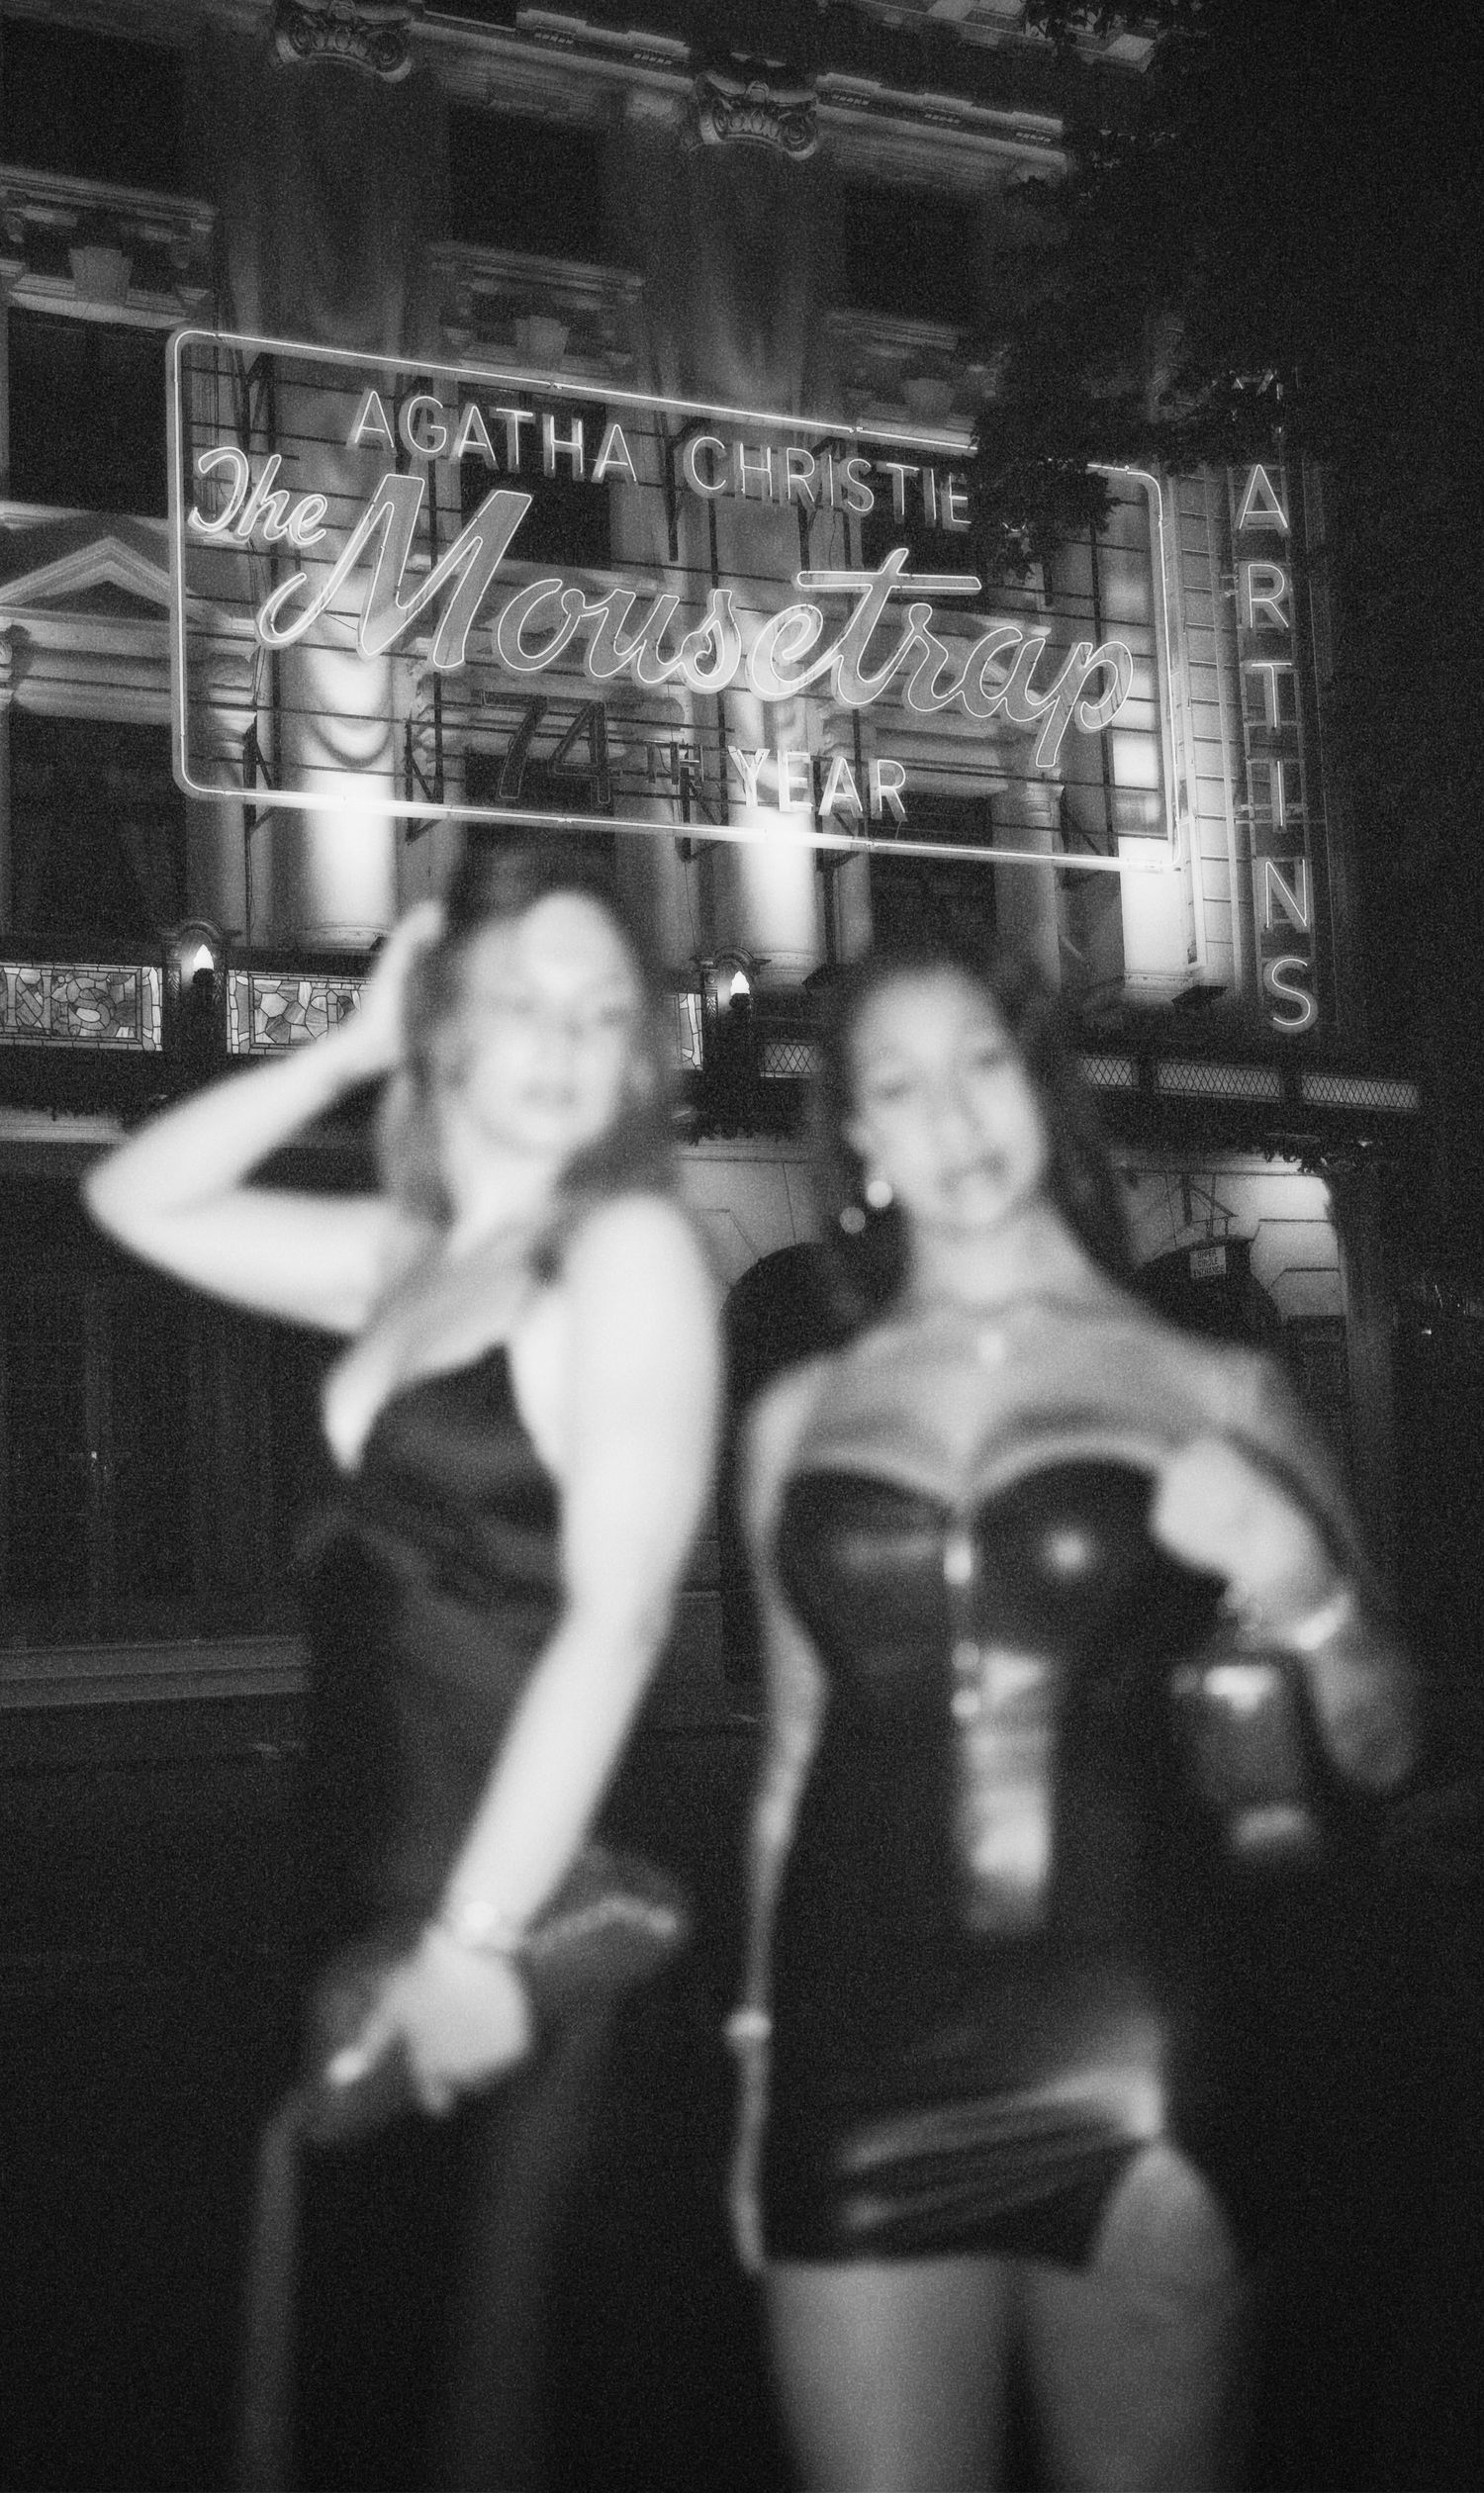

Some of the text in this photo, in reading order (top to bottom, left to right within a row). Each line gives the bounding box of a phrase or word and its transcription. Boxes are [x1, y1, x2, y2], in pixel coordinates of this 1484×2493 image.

[346, 388, 974, 531] AGATHA CHRISTIE
[188, 444, 1135, 769] The Mousetrap
[728, 745, 908, 823] YEAR
